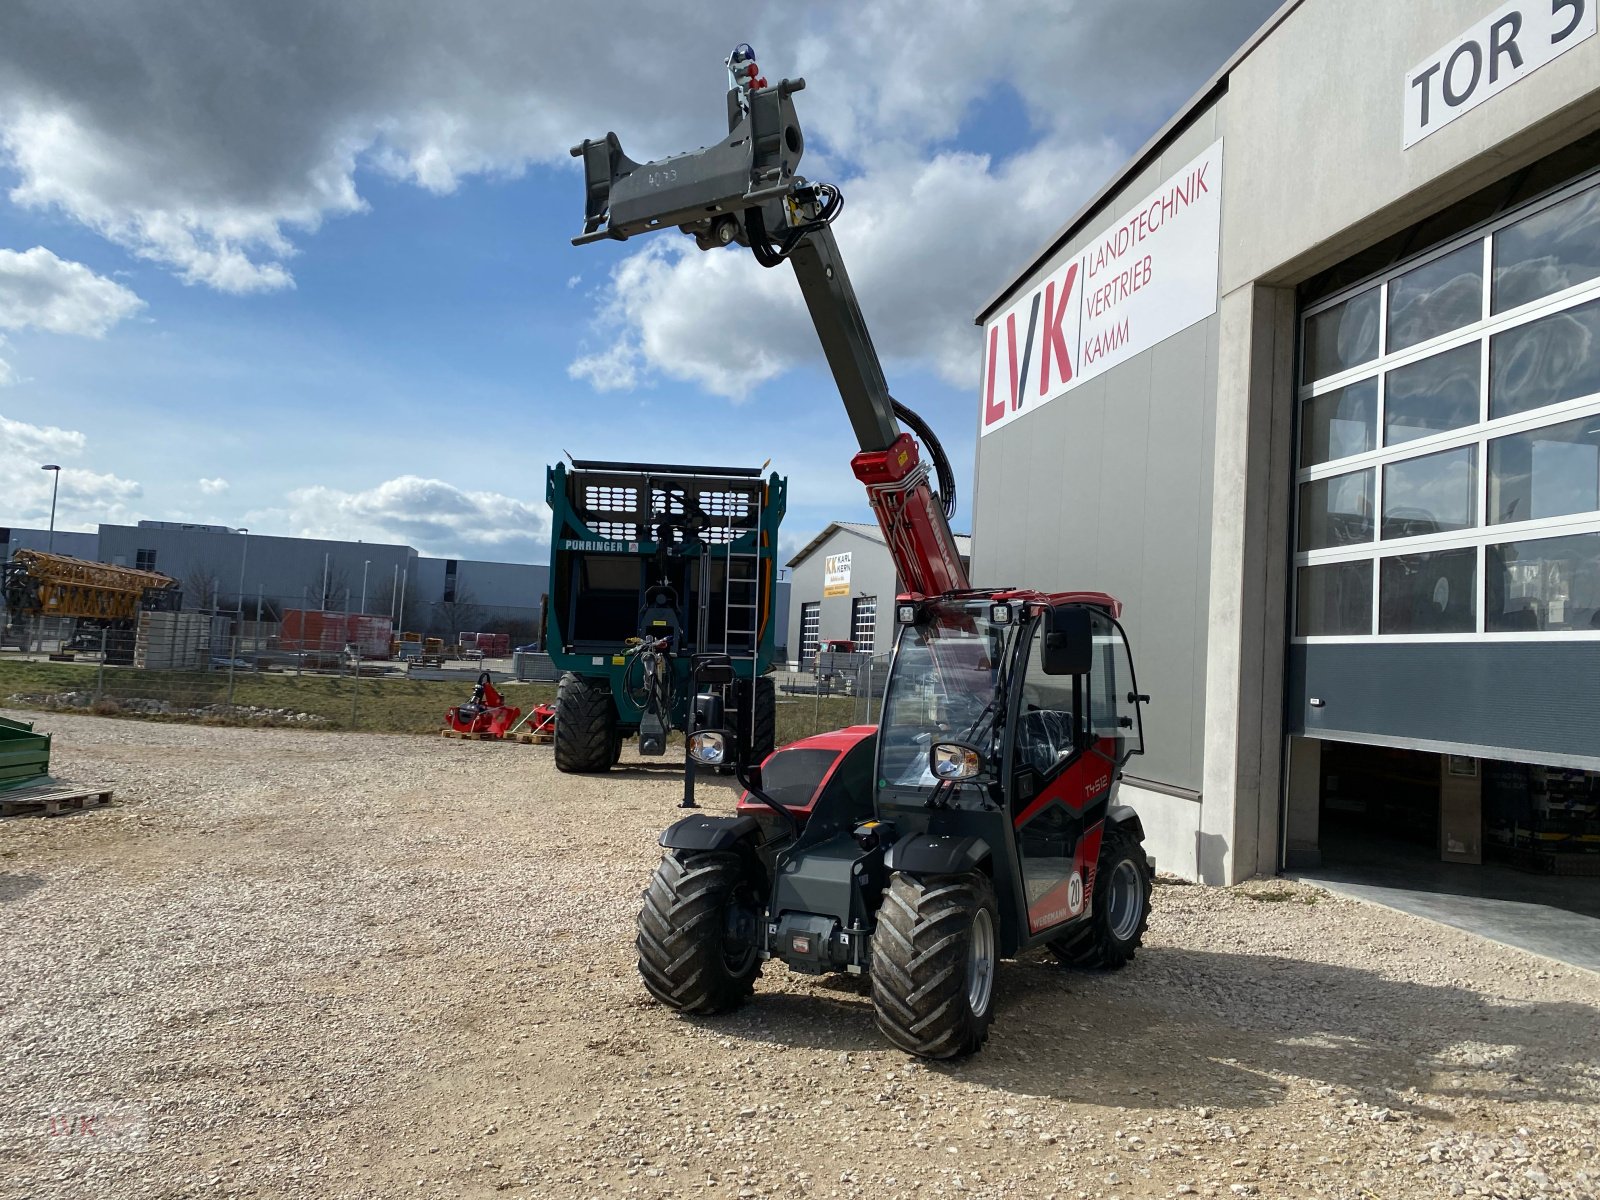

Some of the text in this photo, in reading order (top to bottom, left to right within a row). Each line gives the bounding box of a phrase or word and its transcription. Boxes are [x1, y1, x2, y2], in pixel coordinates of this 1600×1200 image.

[1412, 0, 1585, 128] TOR 5
[1089, 161, 1209, 278] LANDTECHNIK
[1087, 254, 1152, 320] VERTRIEB
[986, 263, 1078, 426] LVK
[1084, 315, 1129, 367] KAMM
[837, 554, 851, 563] KARL
[837, 564, 851, 573] KERN
[1085, 774, 1108, 798] T4512
[1070, 879, 1080, 908] 20
